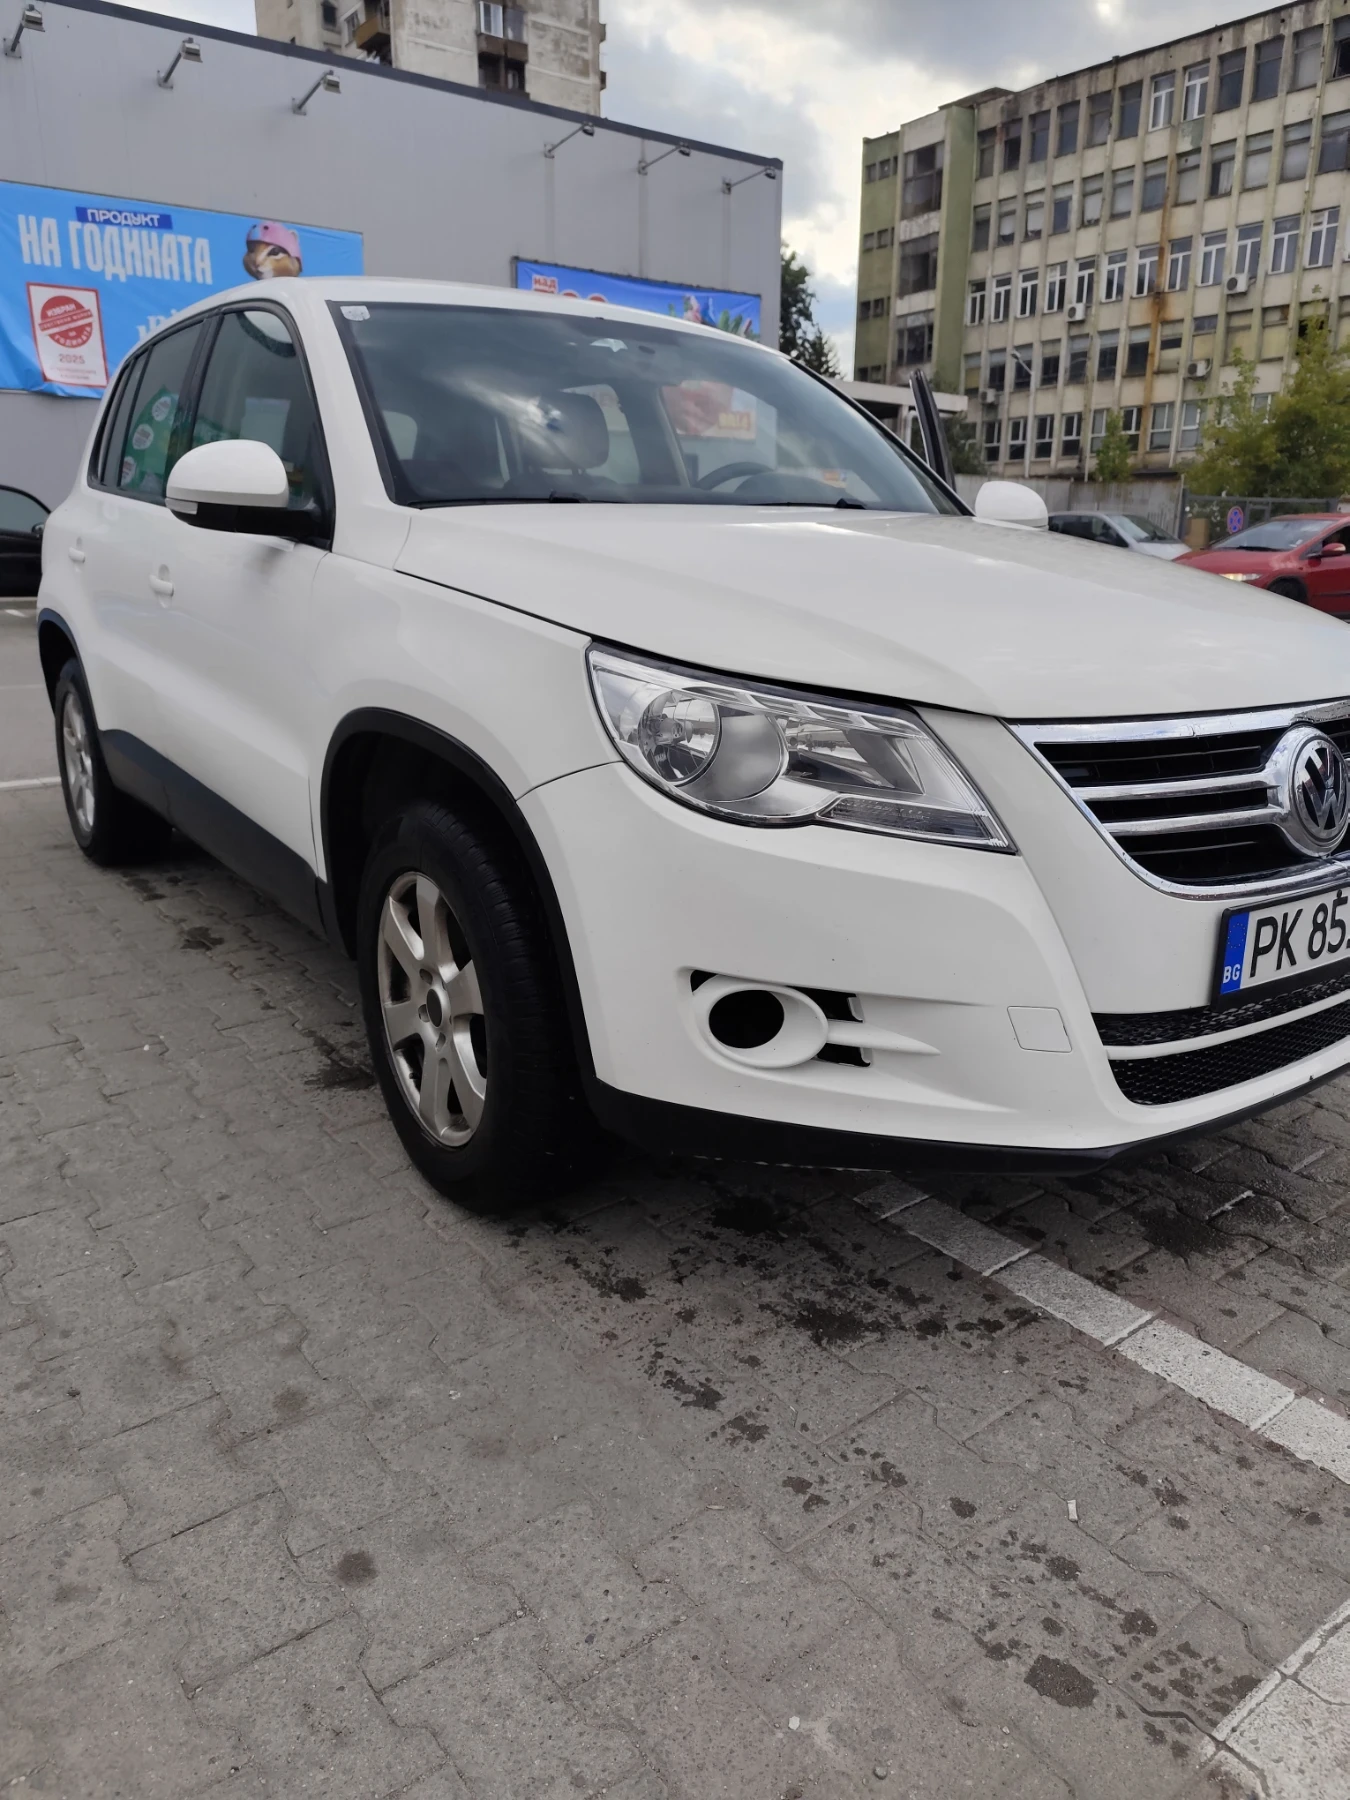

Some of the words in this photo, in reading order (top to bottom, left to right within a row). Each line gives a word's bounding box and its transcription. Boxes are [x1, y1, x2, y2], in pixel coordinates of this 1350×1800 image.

[87, 209, 160, 227] ПРОДУКТ
[18, 214, 62, 267] НА
[68, 221, 213, 285] ГОДИНАТА
[46, 303, 77, 317] ИЗБРАН
[58, 353, 86, 365] 2025
[1249, 908, 1303, 978] PK
[1308, 896, 1350, 960] 85
[1222, 964, 1241, 984] BG
